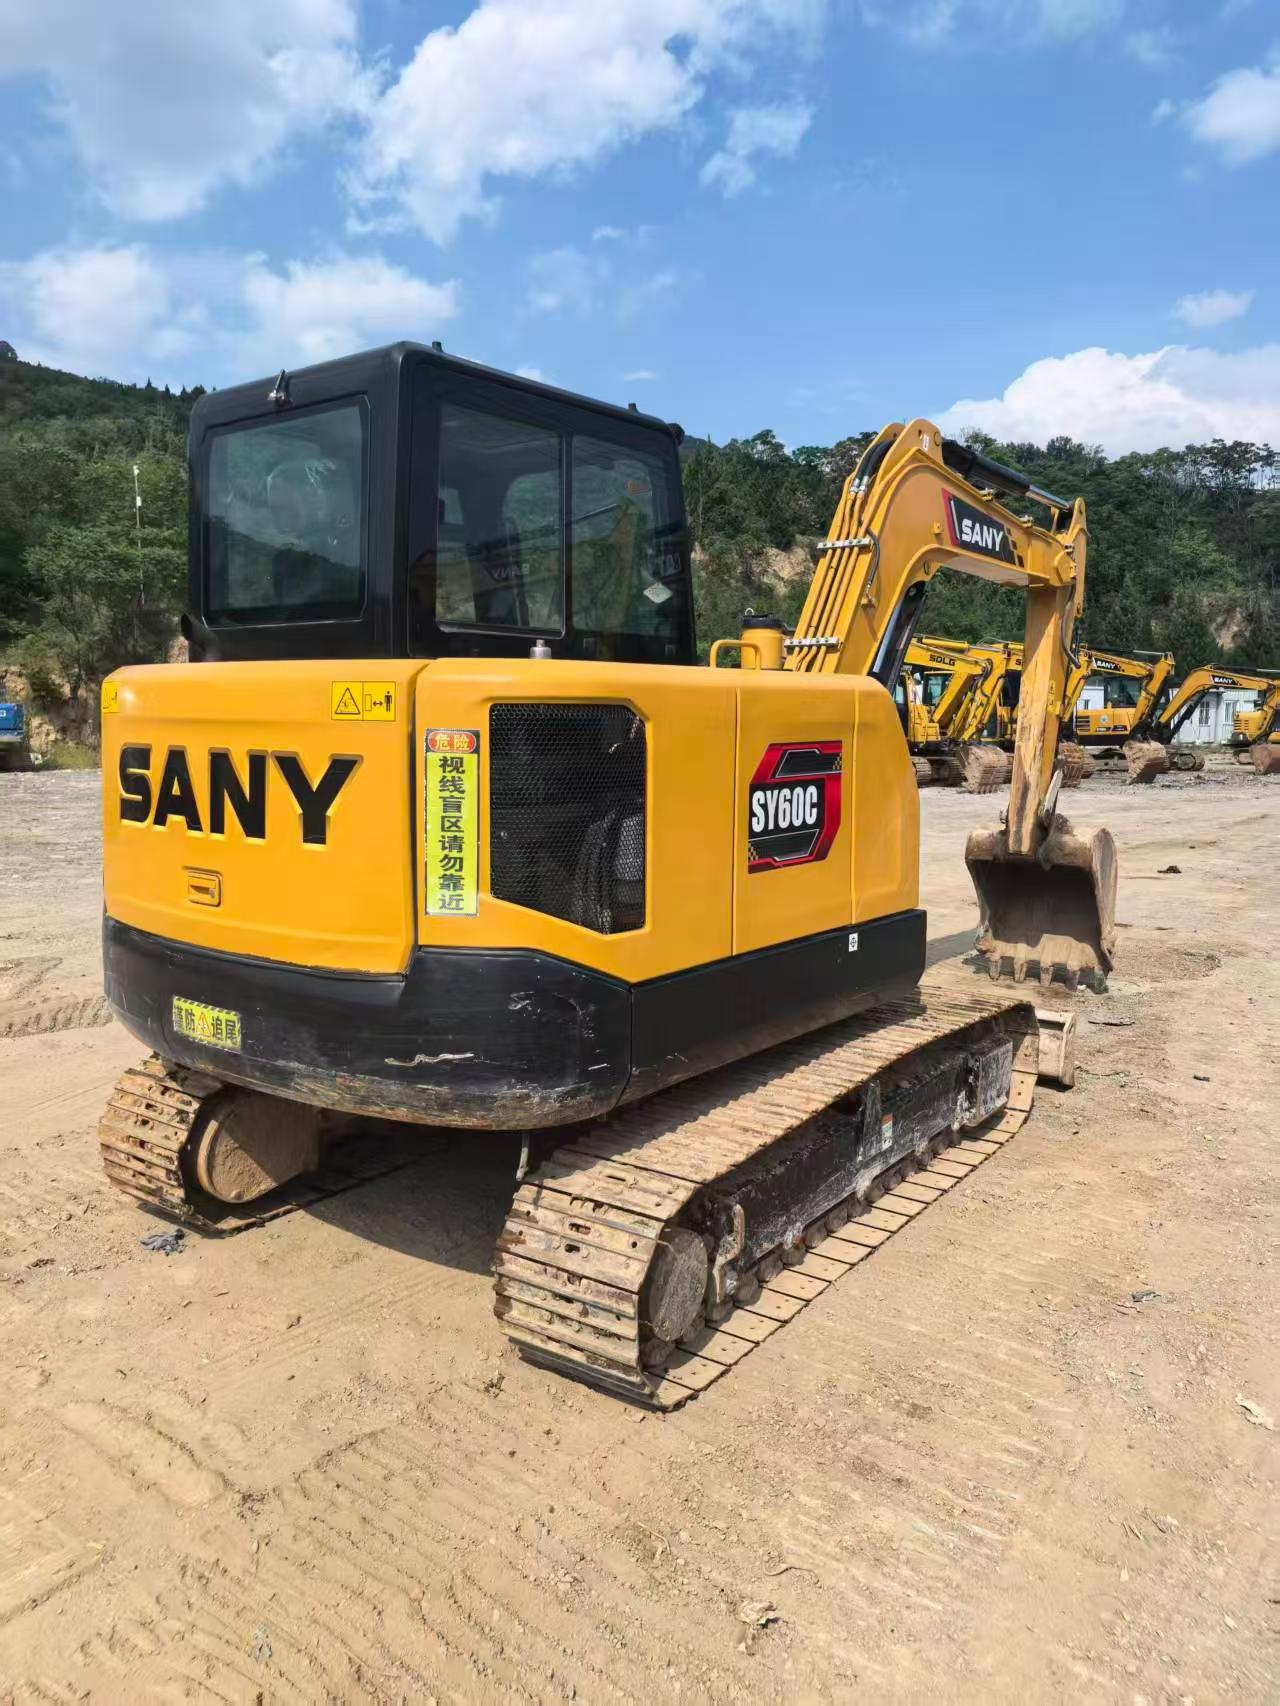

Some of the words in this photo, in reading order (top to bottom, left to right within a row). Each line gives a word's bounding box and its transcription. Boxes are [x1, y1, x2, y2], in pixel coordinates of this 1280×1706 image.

[962, 518, 1004, 551] SANY
[929, 654, 956, 666] SDLG
[1096, 660, 1115, 669] SANY
[435, 734, 470, 750] 危险
[119, 743, 363, 850] SANY
[752, 785, 818, 833] SY60C
[438, 756, 466, 911] 视线盲区请勿靠近
